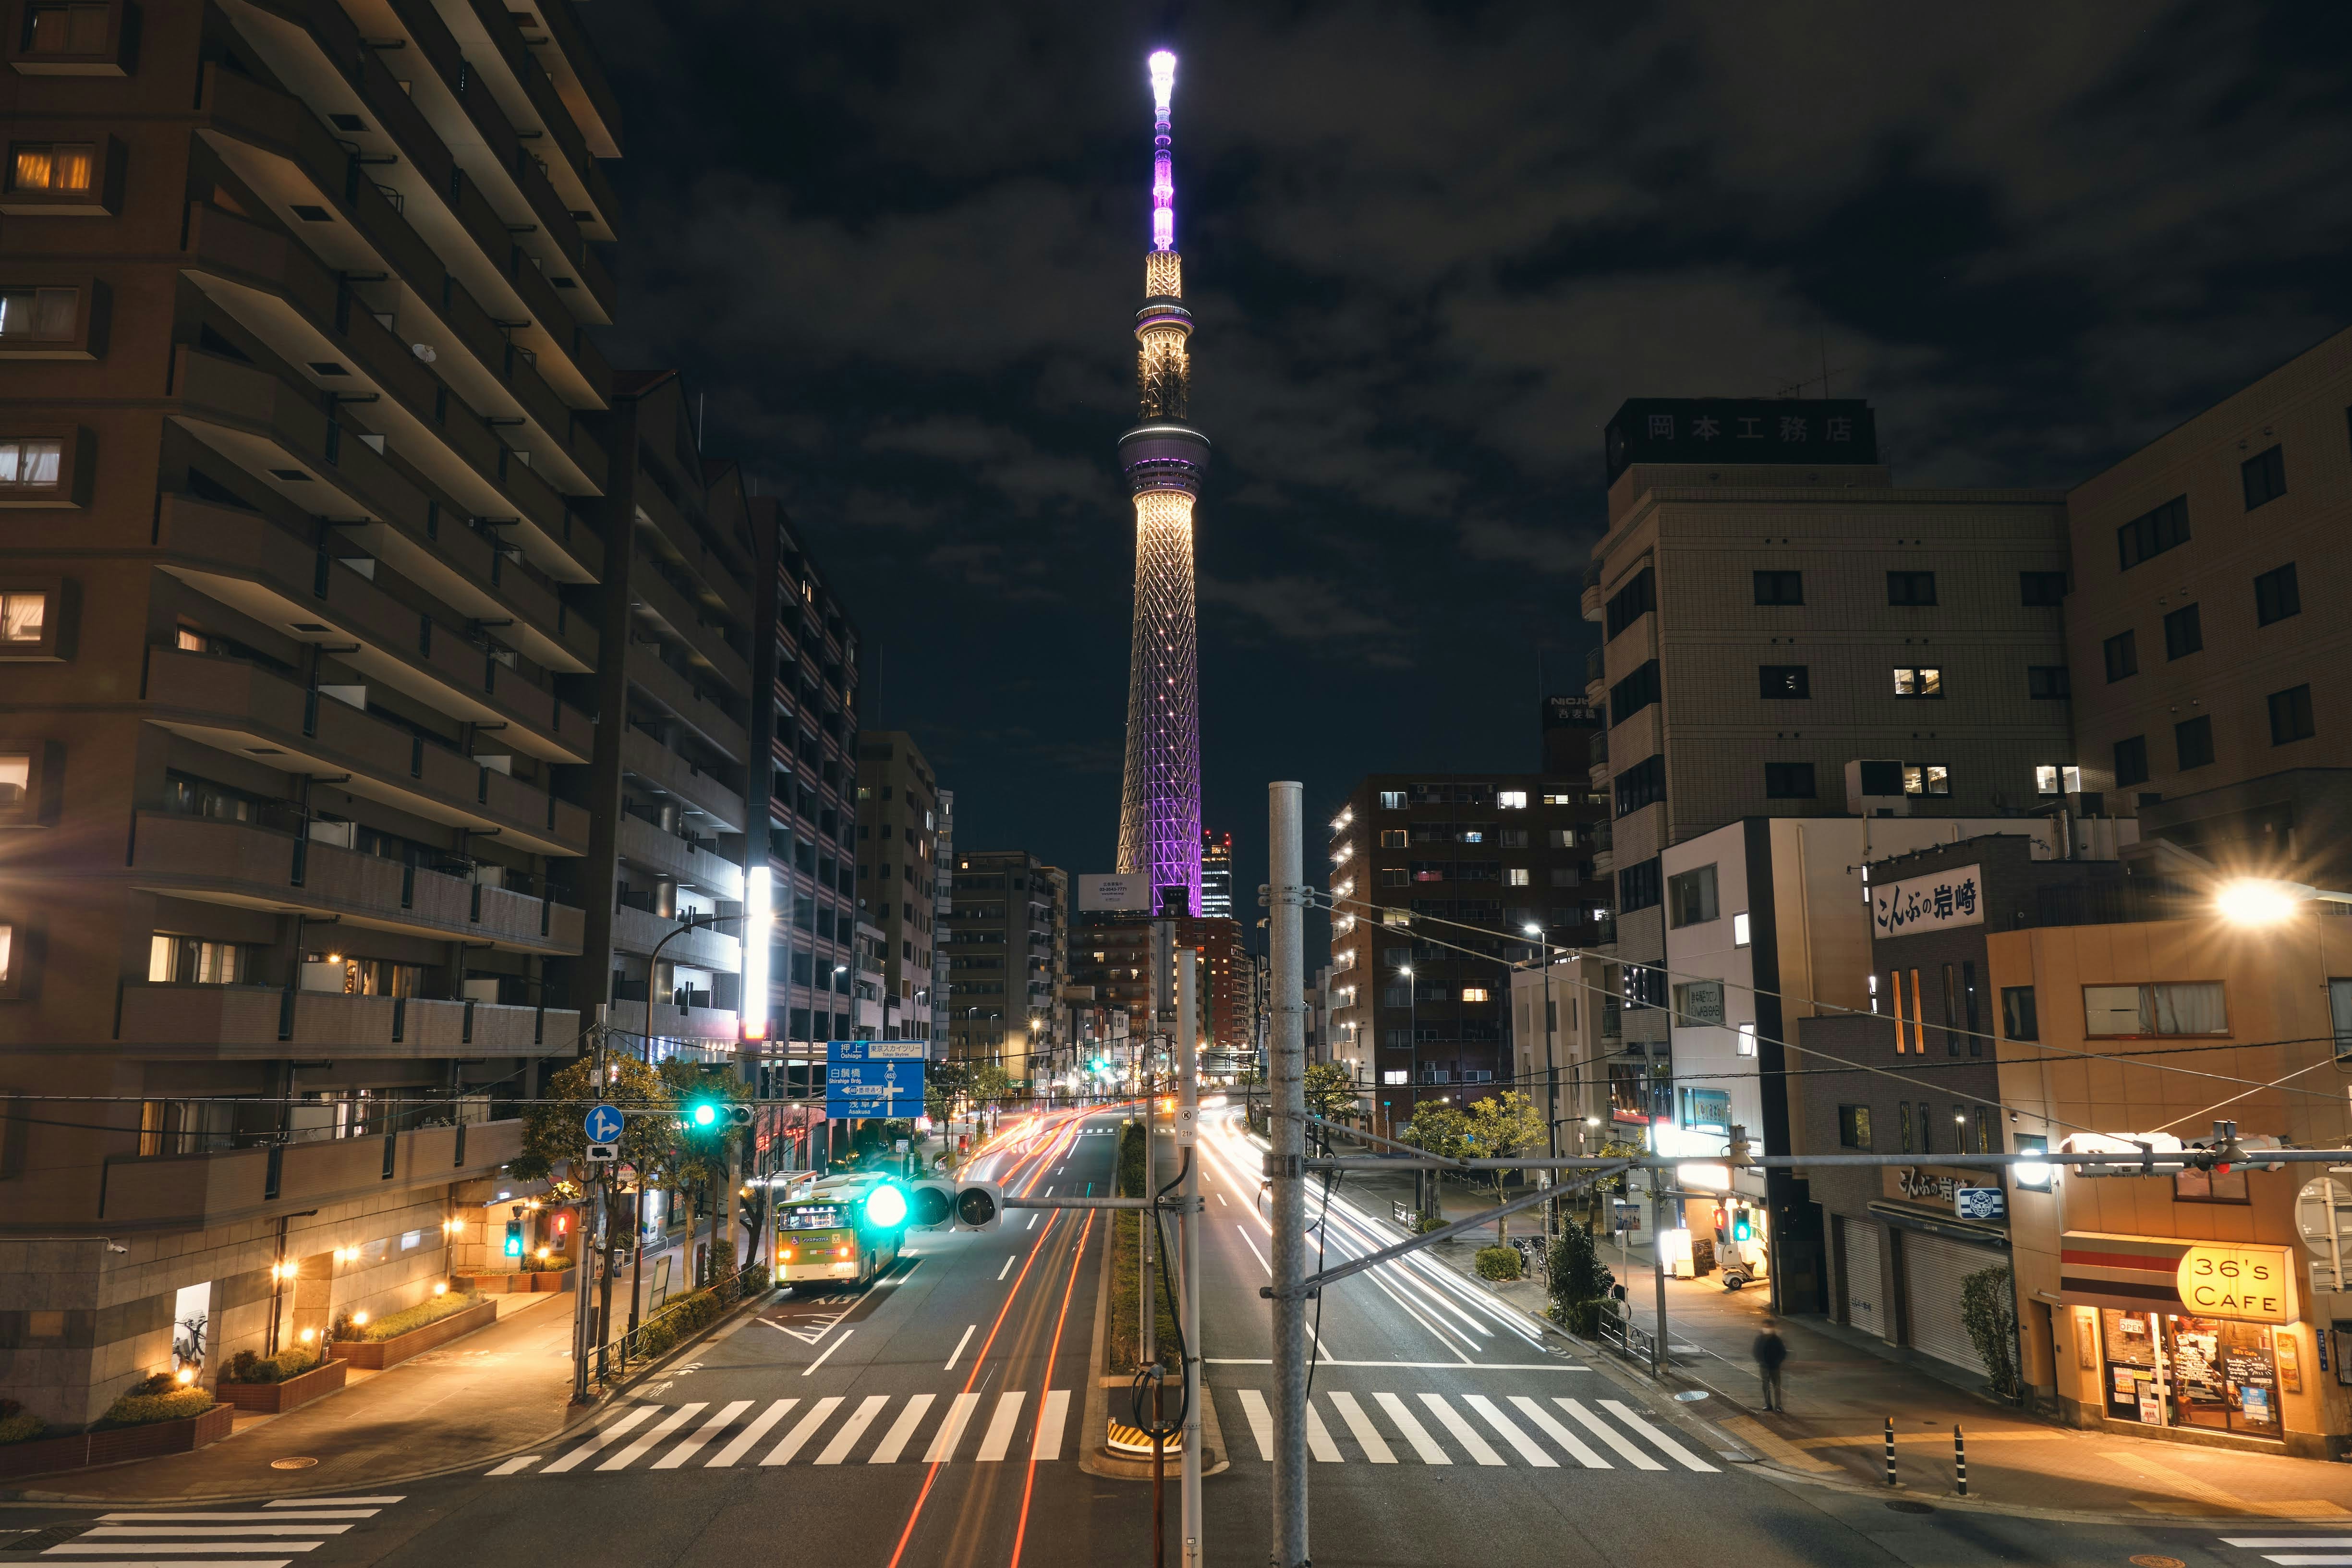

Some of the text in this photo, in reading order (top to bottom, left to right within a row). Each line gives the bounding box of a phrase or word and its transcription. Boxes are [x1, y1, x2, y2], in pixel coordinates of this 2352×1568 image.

[1648, 414, 1852, 442] 岡本工務店
[1878, 878, 1976, 933] こんぶの岩崎
[840, 1044, 862, 1053] 押上
[849, 1099, 870, 1108] 浅草
[2195, 1259, 2268, 1280] 36's
[2121, 1324, 2144, 1333] OPEN
